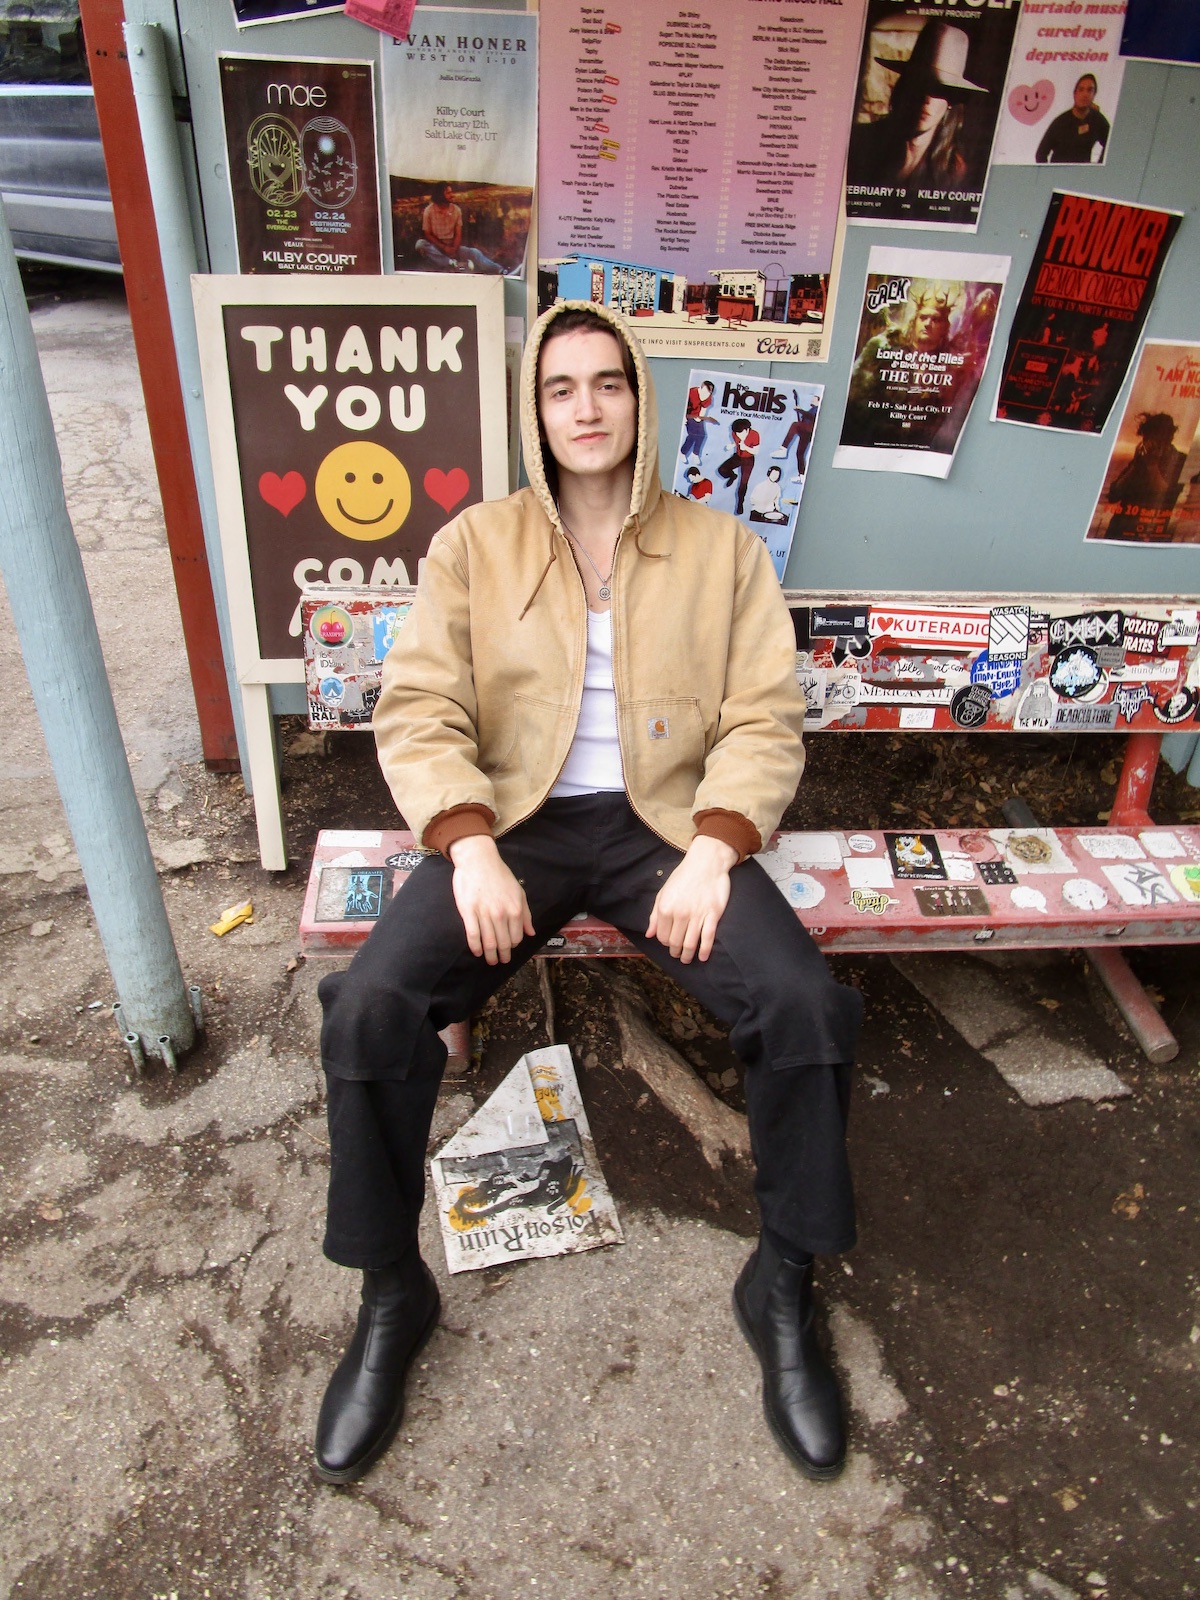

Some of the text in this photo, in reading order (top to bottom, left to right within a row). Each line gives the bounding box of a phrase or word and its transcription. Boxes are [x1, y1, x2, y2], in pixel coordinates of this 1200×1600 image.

[918, 8, 944, 17] MARNY
[945, 9, 982, 19] PROUDFIT
[1025, 0, 1083, 14] hurtado
[1084, 1, 1127, 14] musi
[1037, 24, 1107, 42] cured my
[392, 34, 527, 52] EVAN HONER
[406, 53, 447, 62] WEST
[457, 55, 476, 63] ON
[1025, 47, 1109, 65] depression
[267, 84, 327, 107] mae
[436, 106, 485, 118] Kilby Court
[432, 118, 490, 130] February 12th
[424, 130, 442, 139] Salt
[443, 131, 463, 140] Lake
[484, 132, 498, 141] UT
[895, 188, 907, 198] 19
[917, 189, 948, 200] KILBY
[948, 191, 982, 203] COURT
[266, 209, 297, 218] 02.23
[314, 211, 346, 220] 02.24
[266, 224, 300, 232] EVERGLOW
[1044, 194, 1170, 278] PROVOKER
[262, 250, 358, 265] KILBY COURT
[1036, 264, 1146, 310] DEMON COMPASS
[1043, 297, 1065, 309] TOUR
[1077, 302, 1102, 317] NORTH
[1103, 306, 1134, 322] AMERICA
[240, 324, 464, 375] THANK
[684, 340, 746, 348] SNSPRESENTS.COM
[756, 337, 800, 356] Coors
[876, 347, 965, 365] Lord of the Flies
[900, 361, 919, 370] Birds
[928, 363, 947, 372] Bees
[879, 369, 953, 386] THE TOUR
[1165, 368, 1186, 382] AM
[1186, 369, 1200, 384] NO
[736, 383, 750, 391] the
[1171, 384, 1178, 398] I
[721, 381, 788, 414] hails
[283, 383, 427, 432] YOU
[720, 408, 740, 416] What's
[752, 412, 772, 420] Motive
[867, 401, 881, 409] Feb
[894, 402, 908, 411] Salt
[908, 403, 924, 412] Lake
[941, 405, 953, 414] UT
[889, 411, 927, 421] Kilby Court
[1124, 504, 1140, 516] 10
[776, 550, 786, 558] UT
[292, 556, 428, 592] COM
[992, 606, 1030, 616] WASATCH
[871, 617, 876, 630] I
[893, 619, 990, 637] KUTERADIO
[1123, 617, 1159, 636] POTATO
[988, 652, 1027, 662] SEASONS
[974, 669, 1021, 682] MAN CRUSH
[1019, 718, 1049, 727] THE WILD
